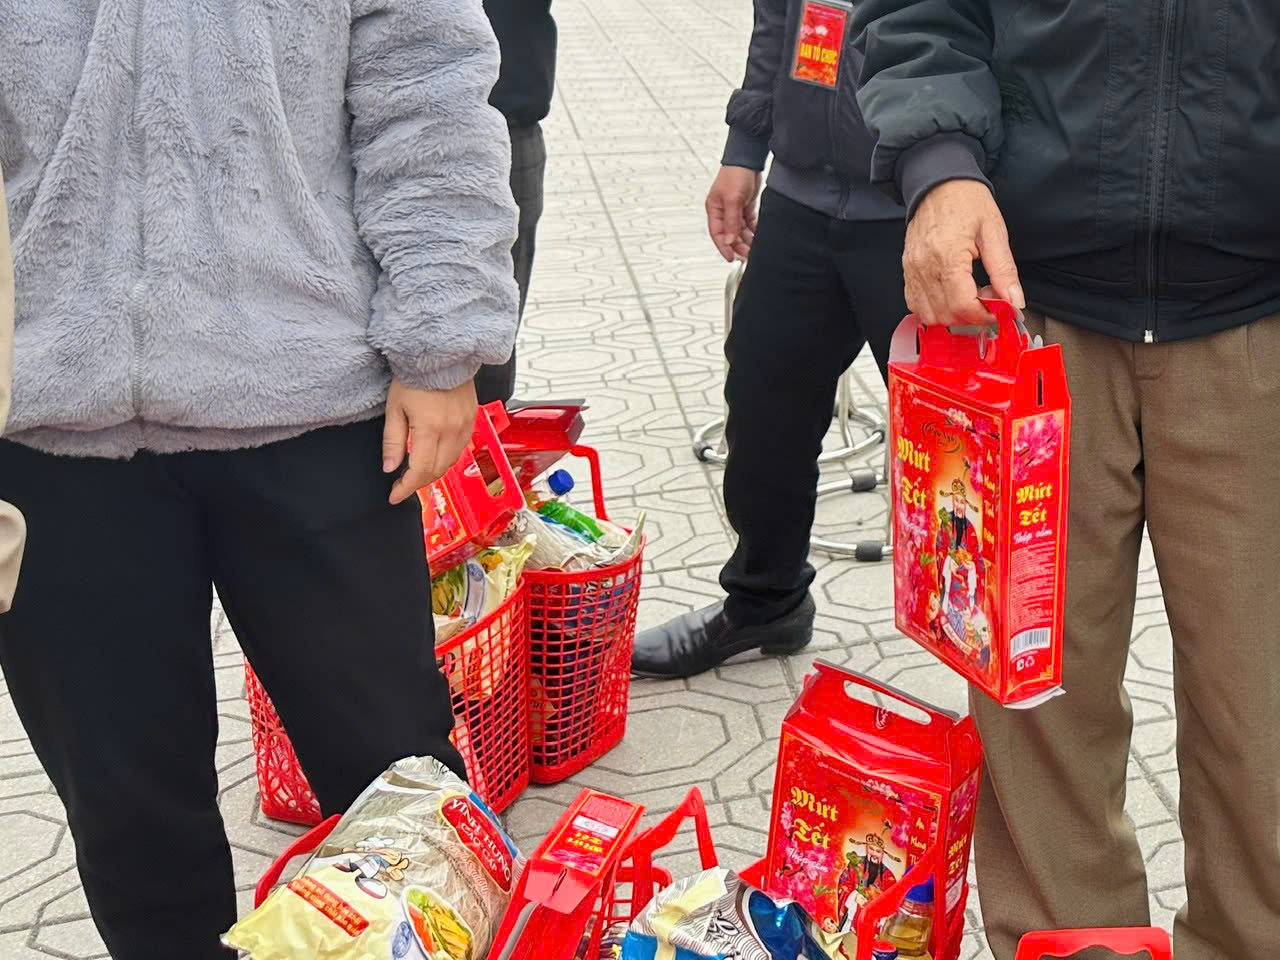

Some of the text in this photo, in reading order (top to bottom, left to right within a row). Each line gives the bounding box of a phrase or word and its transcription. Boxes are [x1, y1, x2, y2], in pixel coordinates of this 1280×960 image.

[898, 435, 931, 473] Mứt
[902, 476, 927, 510] Tết
[1016, 482, 1052, 505] Mứt
[1019, 502, 1047, 527] Tết
[790, 786, 839, 822] Mứt
[461, 822, 481, 847] CAO
[793, 817, 832, 850] Tết
